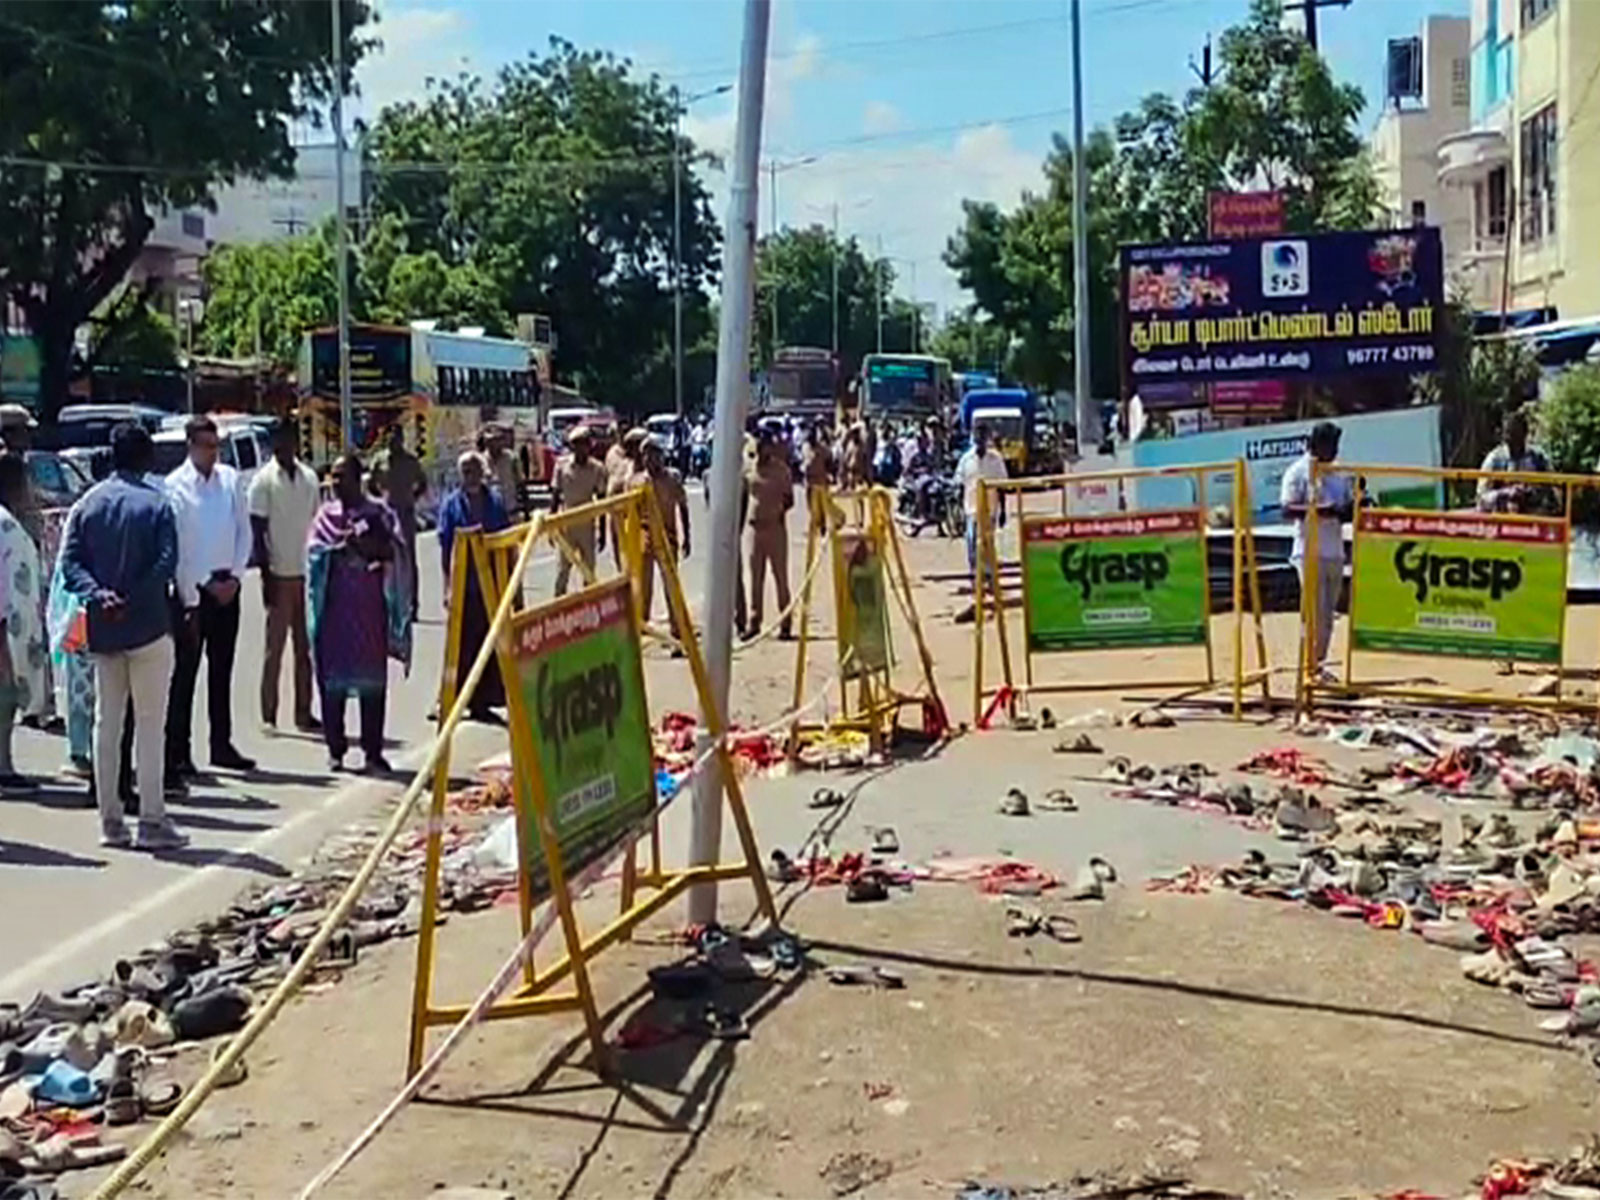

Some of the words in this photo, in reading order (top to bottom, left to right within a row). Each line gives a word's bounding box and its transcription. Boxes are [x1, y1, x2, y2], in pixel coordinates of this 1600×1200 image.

[1130, 312, 1188, 352] சூர்யா
[1358, 298, 1433, 335] ஸ்டோர்
[1249, 438, 1308, 459] HATSUN
[1061, 542, 1168, 601] Grasp
[1394, 541, 1522, 603] Grasp
[536, 658, 622, 777] Grasp
